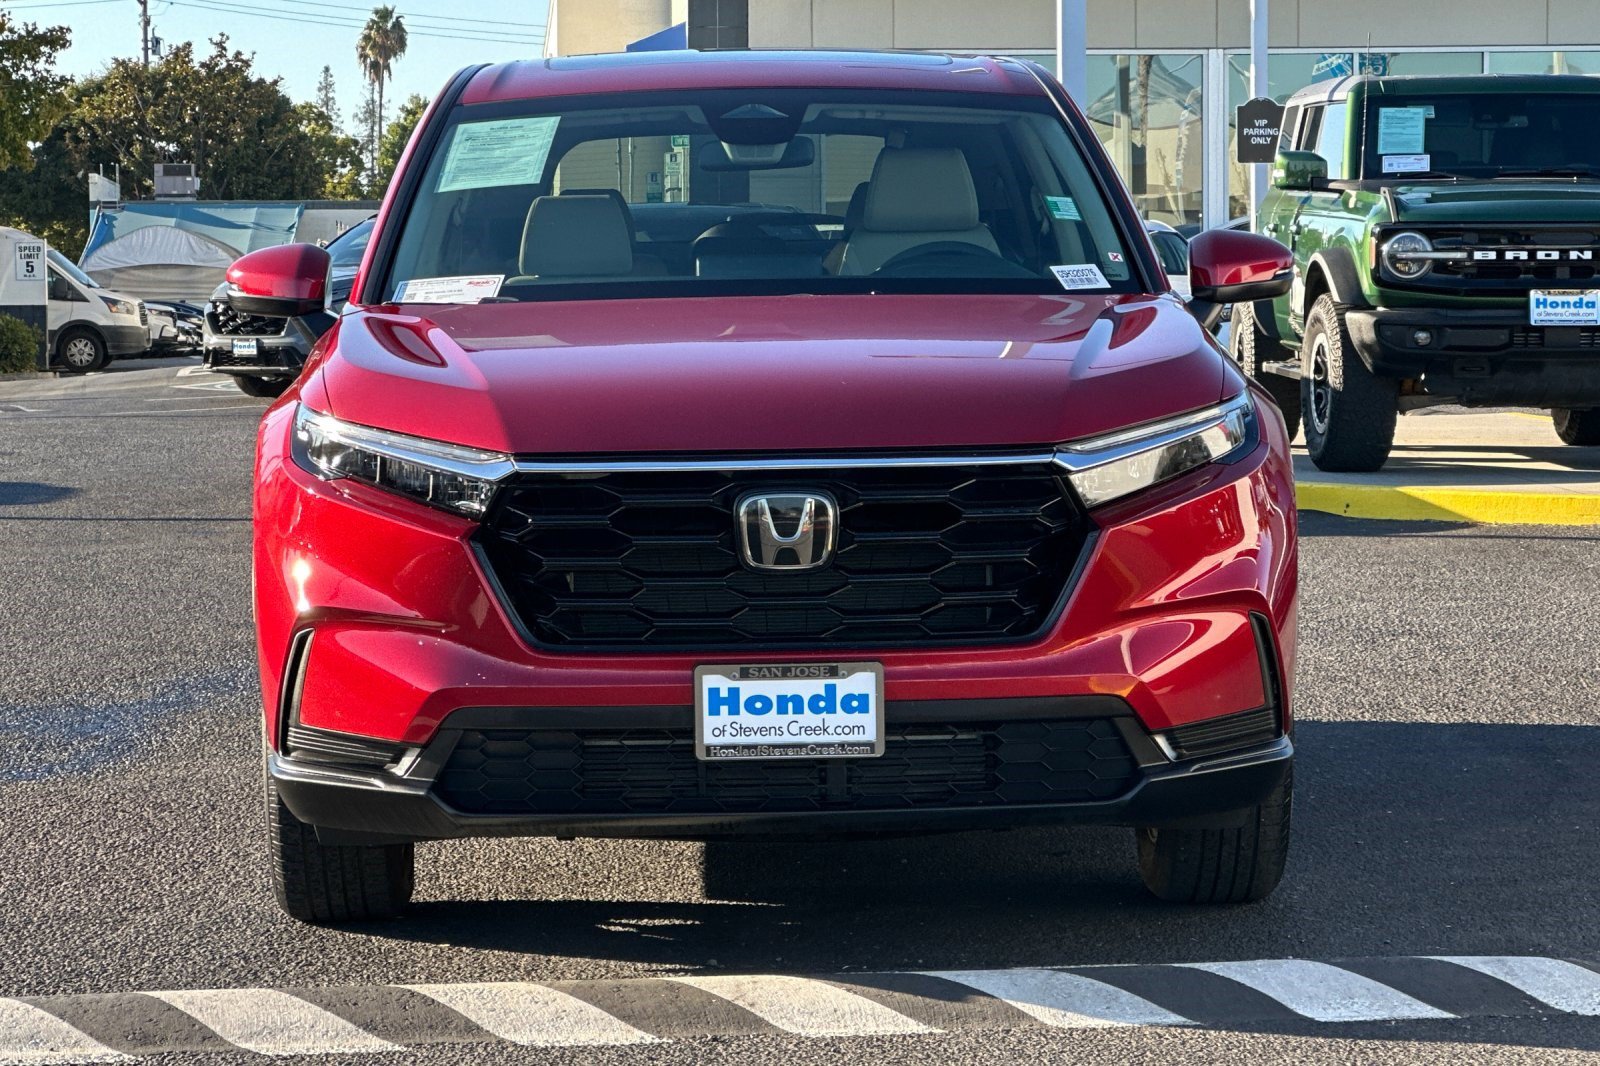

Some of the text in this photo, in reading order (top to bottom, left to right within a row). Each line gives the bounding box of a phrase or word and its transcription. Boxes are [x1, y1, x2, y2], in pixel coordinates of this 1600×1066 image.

[1254, 119, 1268, 127] VIP
[1243, 128, 1279, 136] PARKING
[1250, 136, 1272, 144] ONLY
[25, 260, 35, 273] 5
[1535, 297, 1596, 309] Honda
[1543, 310, 1564, 318] Stevens
[1564, 310, 1595, 318] Creek.com
[748, 666, 830, 678] SAN JOSE
[707, 683, 870, 716] Honda
[711, 718, 866, 738] of Stevens Creek.com
[709, 744, 871, 757] HondaofStevensCreek.com
